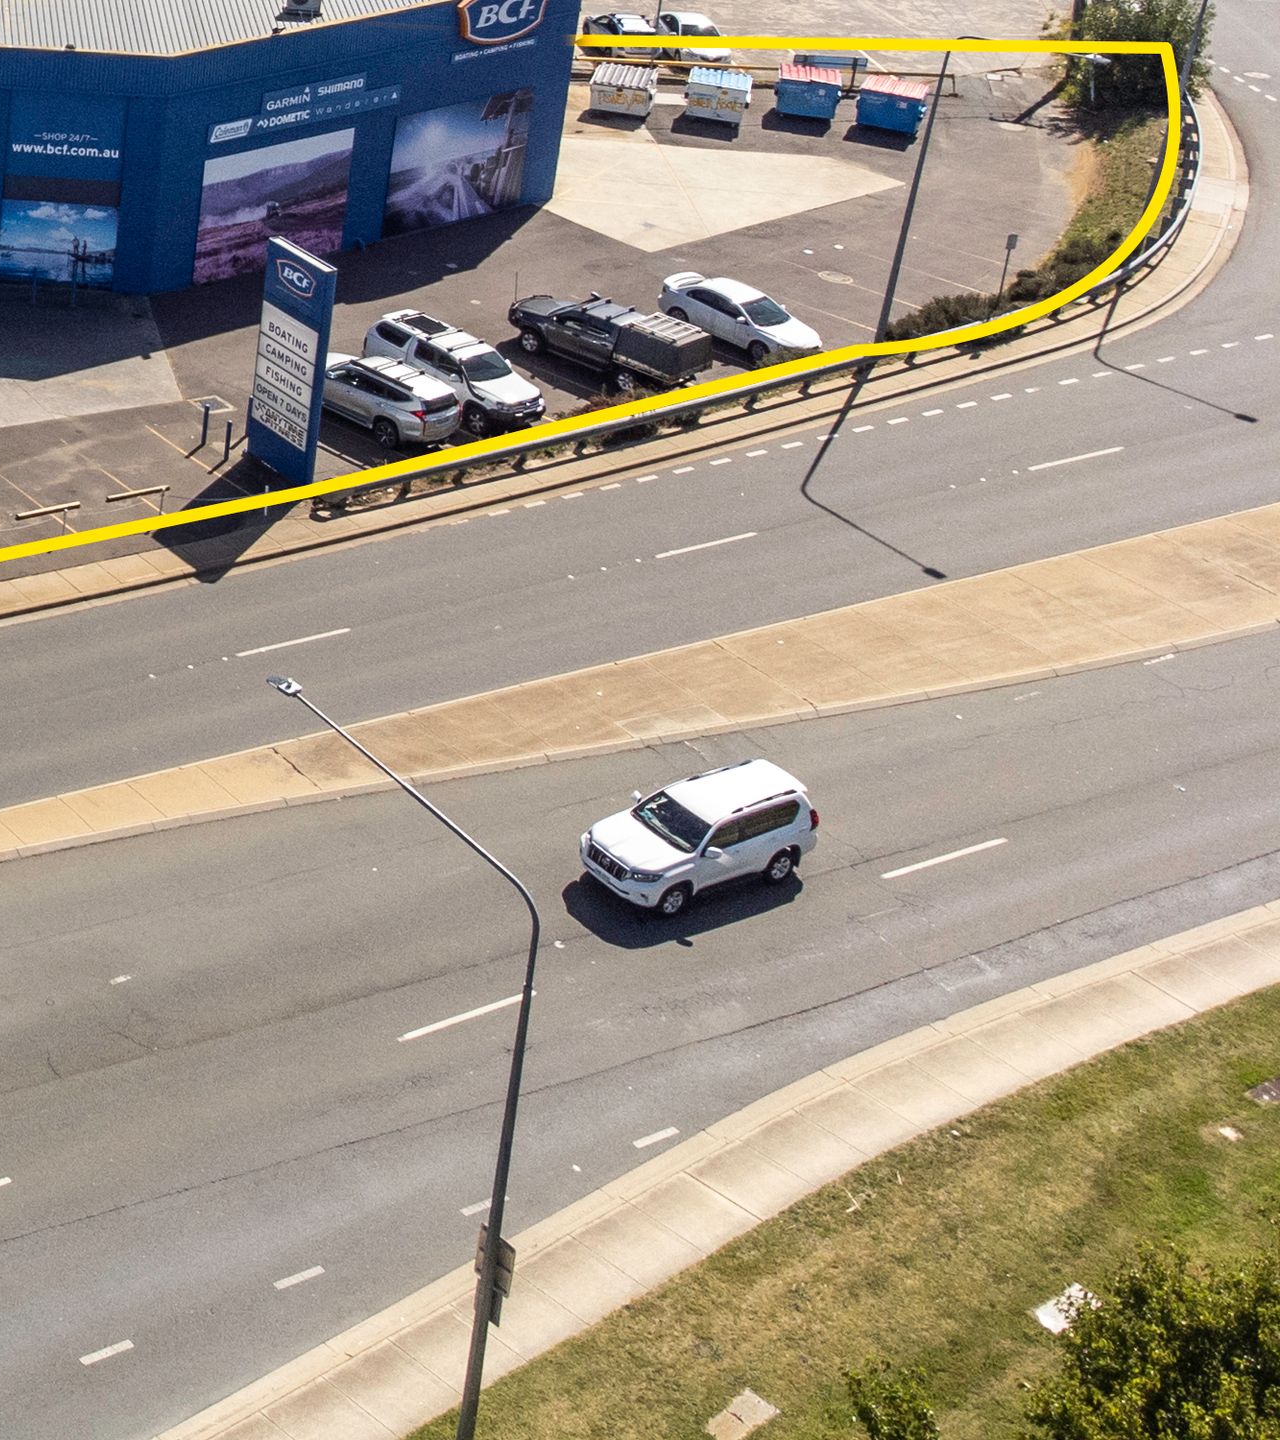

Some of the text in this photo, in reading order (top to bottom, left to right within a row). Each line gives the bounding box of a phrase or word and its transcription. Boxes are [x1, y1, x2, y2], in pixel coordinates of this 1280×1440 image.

[318, 78, 364, 96] SHIMANO
[267, 93, 311, 110] GARMIN
[270, 110, 310, 127] DOMETIC
[42, 132, 90, 142] SHOP 24/7
[12, 144, 119, 158] www.bcf.com.au
[283, 266, 310, 288] BCF
[268, 322, 308, 354] BOATING
[265, 343, 307, 376] CAMPING
[265, 366, 302, 397] FISHING
[256, 383, 278, 405] OPEN
[286, 404, 307, 423] DAYS
[265, 407, 304, 440] ANYTIME
